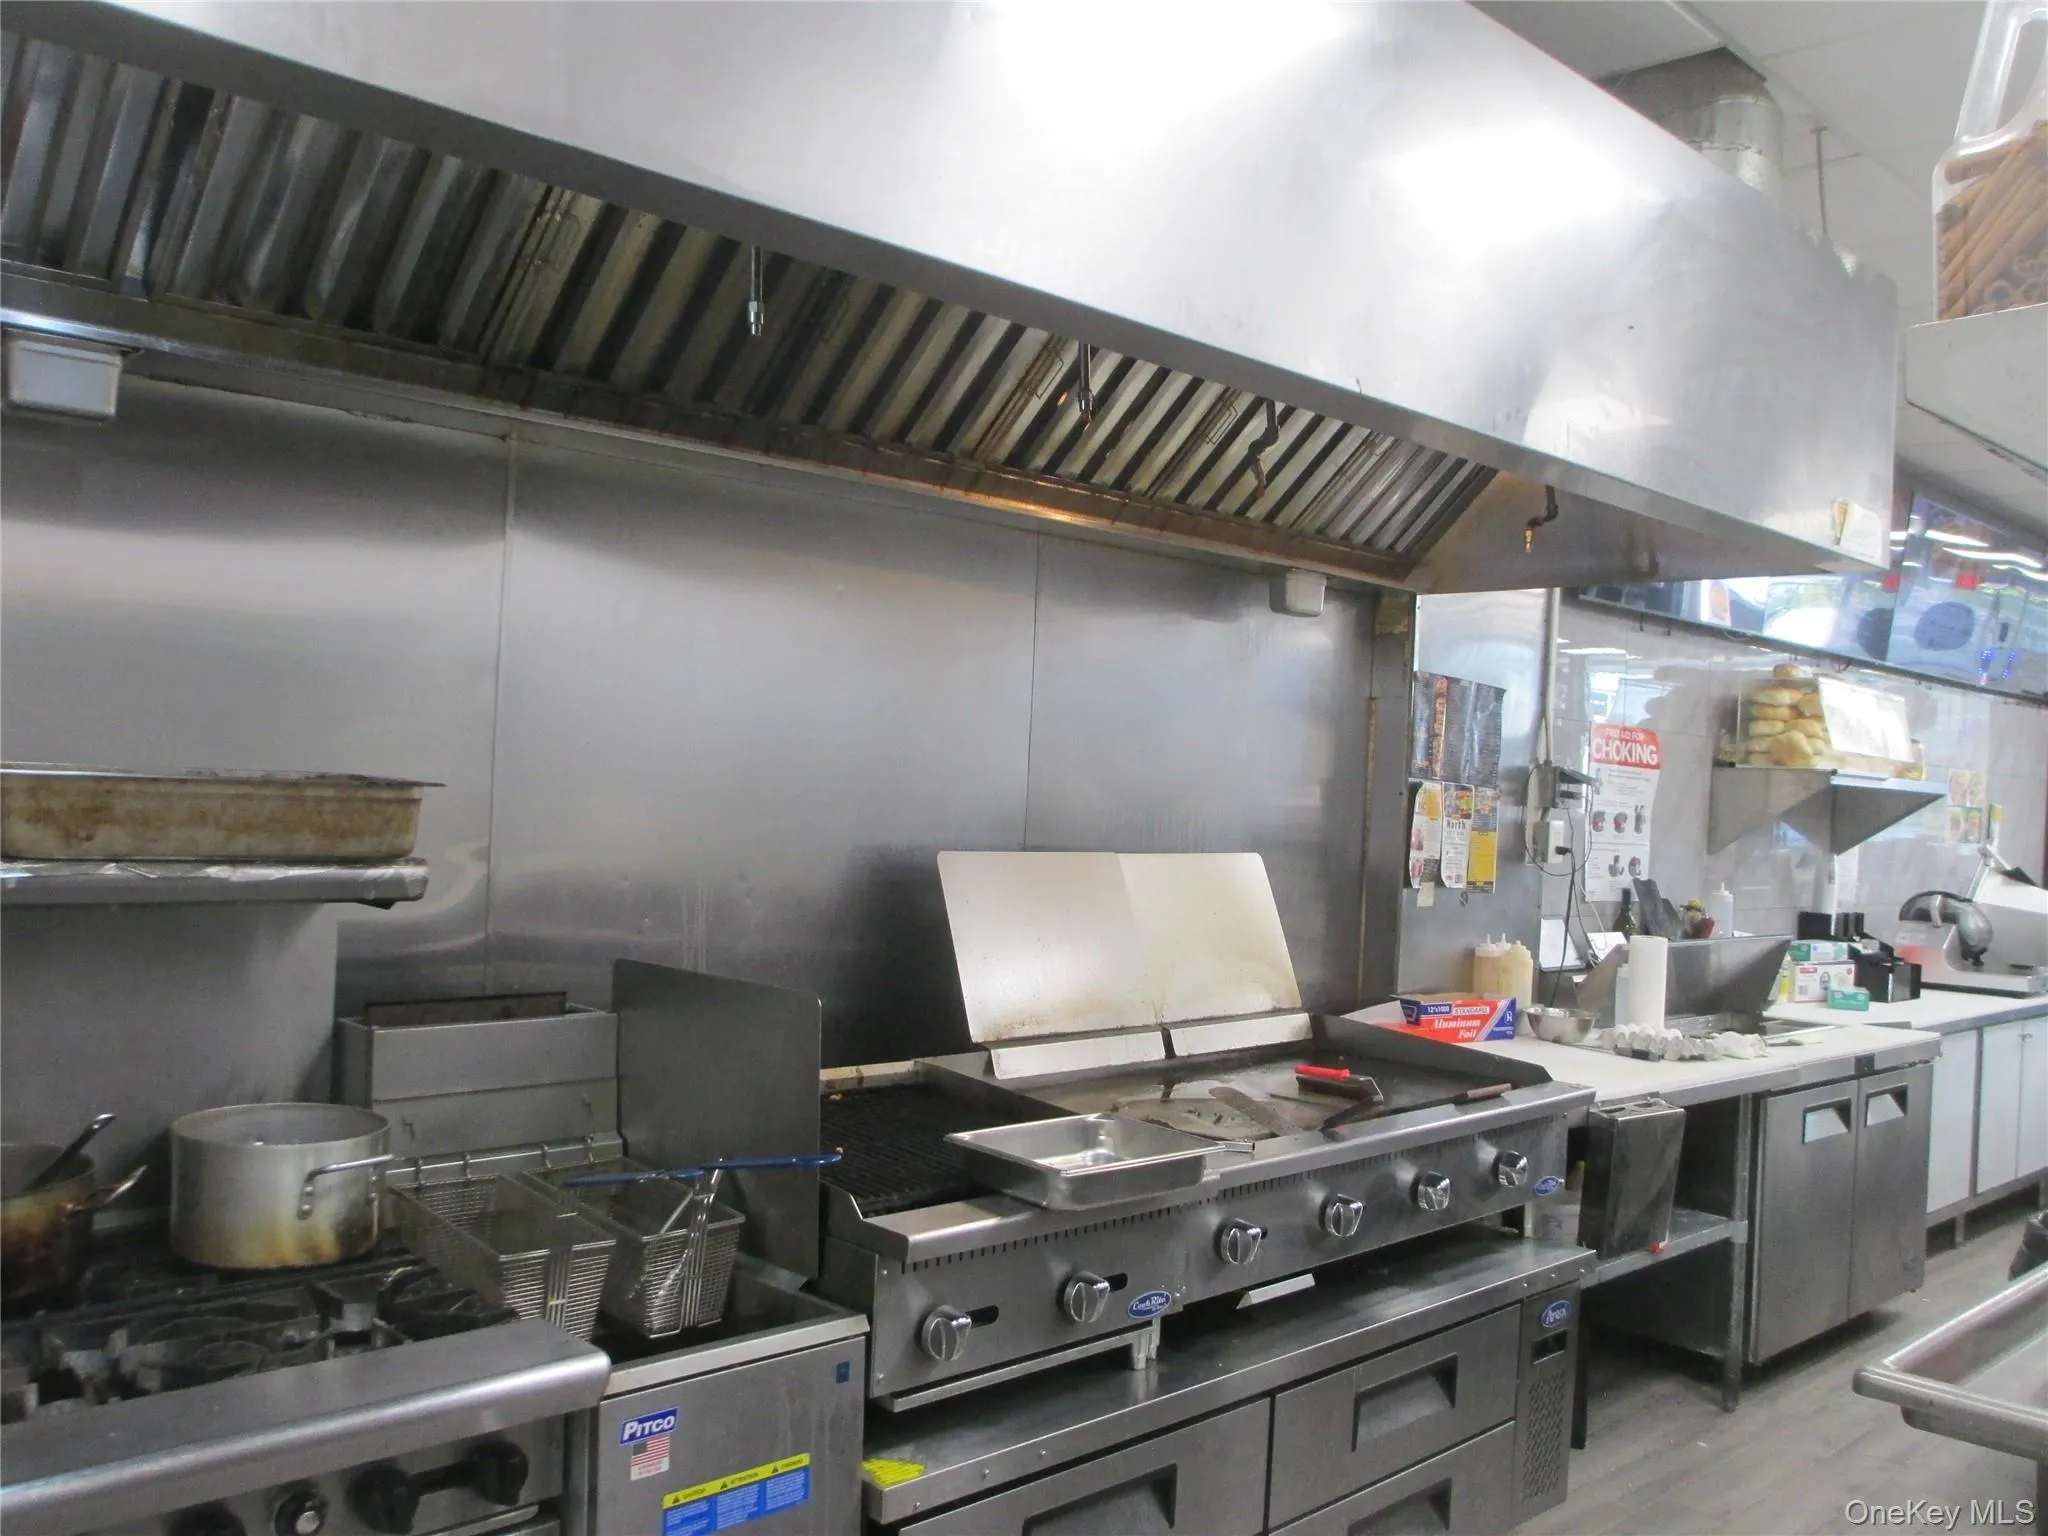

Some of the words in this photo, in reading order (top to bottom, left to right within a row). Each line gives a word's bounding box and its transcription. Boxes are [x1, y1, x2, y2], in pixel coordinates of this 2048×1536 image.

[1593, 738, 1658, 765] CHOKING
[1434, 1019, 1480, 1029] Aluminum
[1459, 1029, 1477, 1039] Foil
[622, 1415, 676, 1441] PITCO
